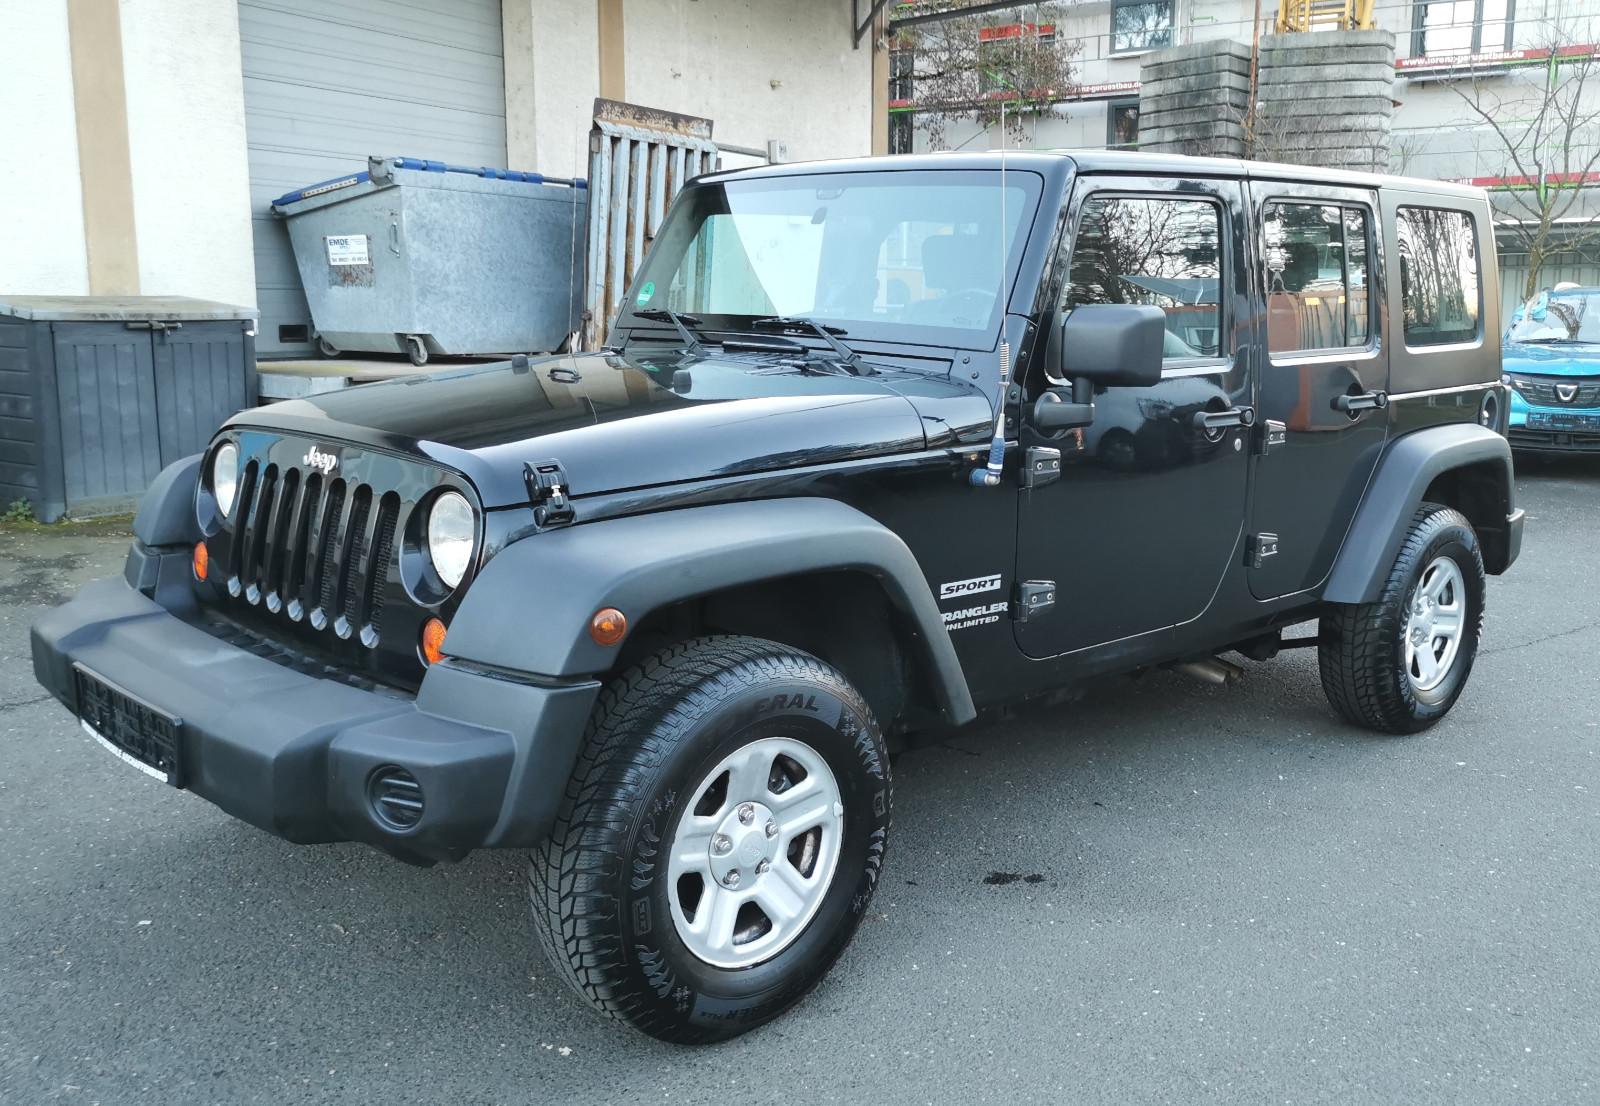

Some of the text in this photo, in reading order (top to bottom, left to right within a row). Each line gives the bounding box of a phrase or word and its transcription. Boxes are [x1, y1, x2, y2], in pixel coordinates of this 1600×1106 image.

[328, 238, 351, 246] EMDE
[303, 445, 337, 475] Jeep
[944, 579, 997, 595] SPORT
[941, 601, 1009, 623] RANGLER
